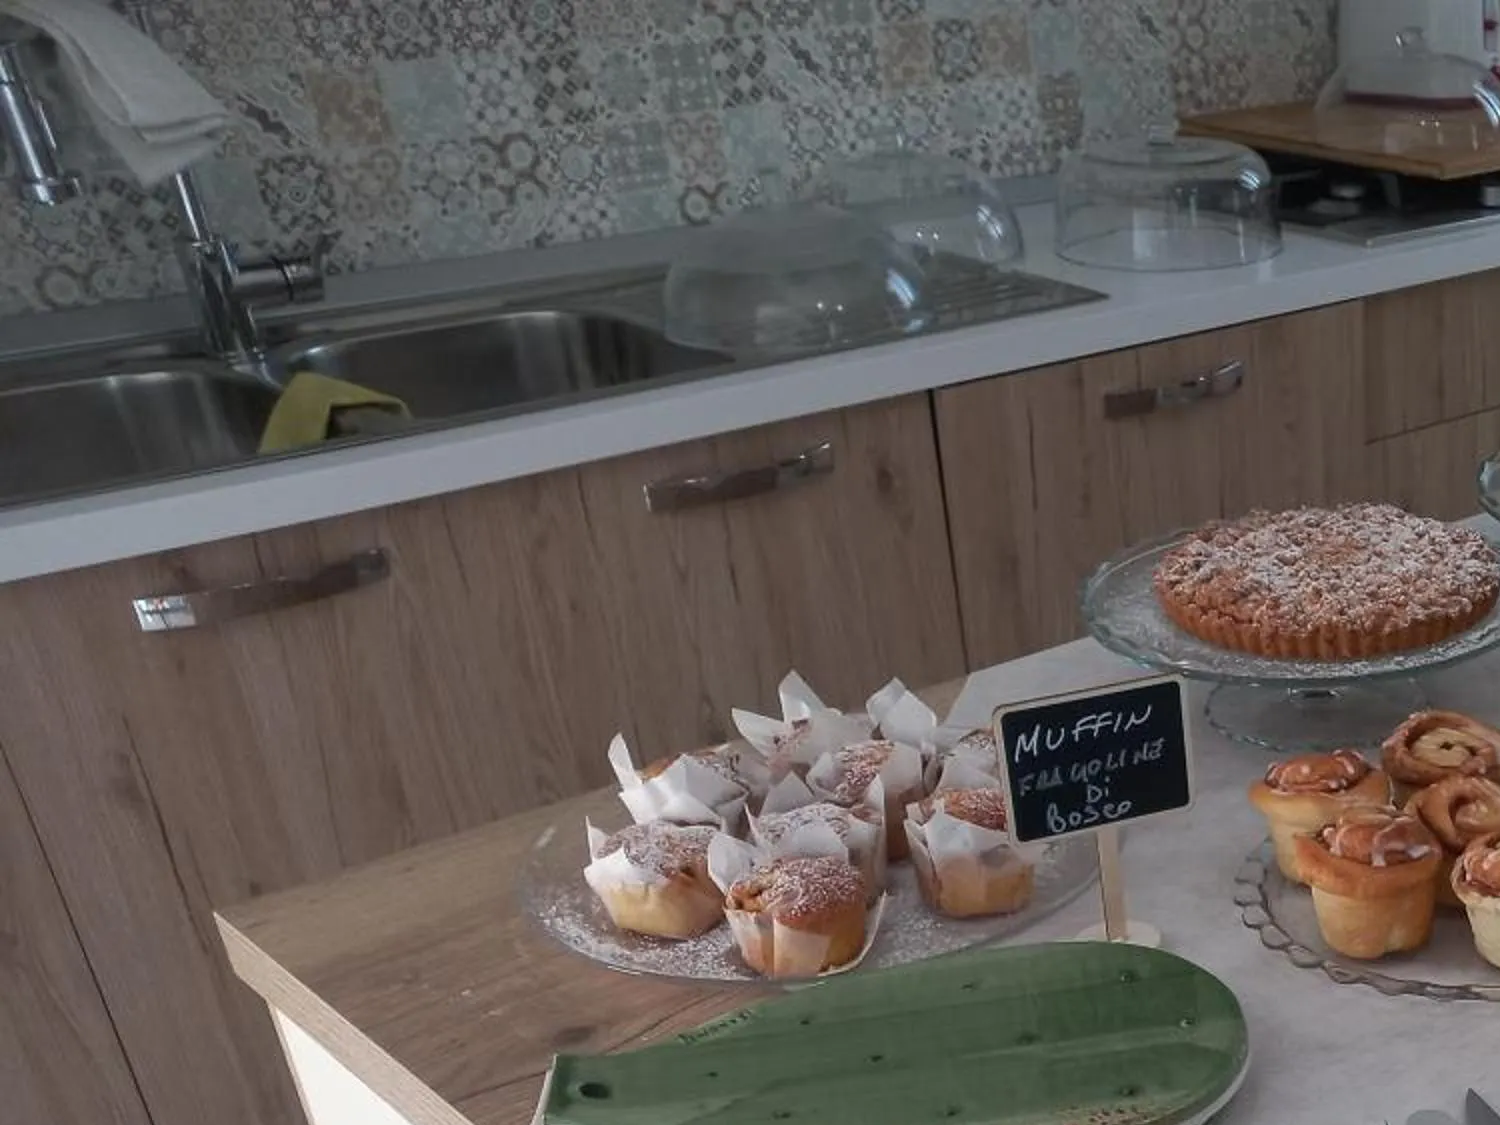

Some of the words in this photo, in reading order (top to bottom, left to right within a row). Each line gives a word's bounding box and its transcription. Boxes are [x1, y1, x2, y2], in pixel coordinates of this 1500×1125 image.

[1014, 704, 1152, 763] MUFFIN
[1018, 738, 1166, 797] FRAGOLINE
[1046, 800, 1132, 833] BOSCO
